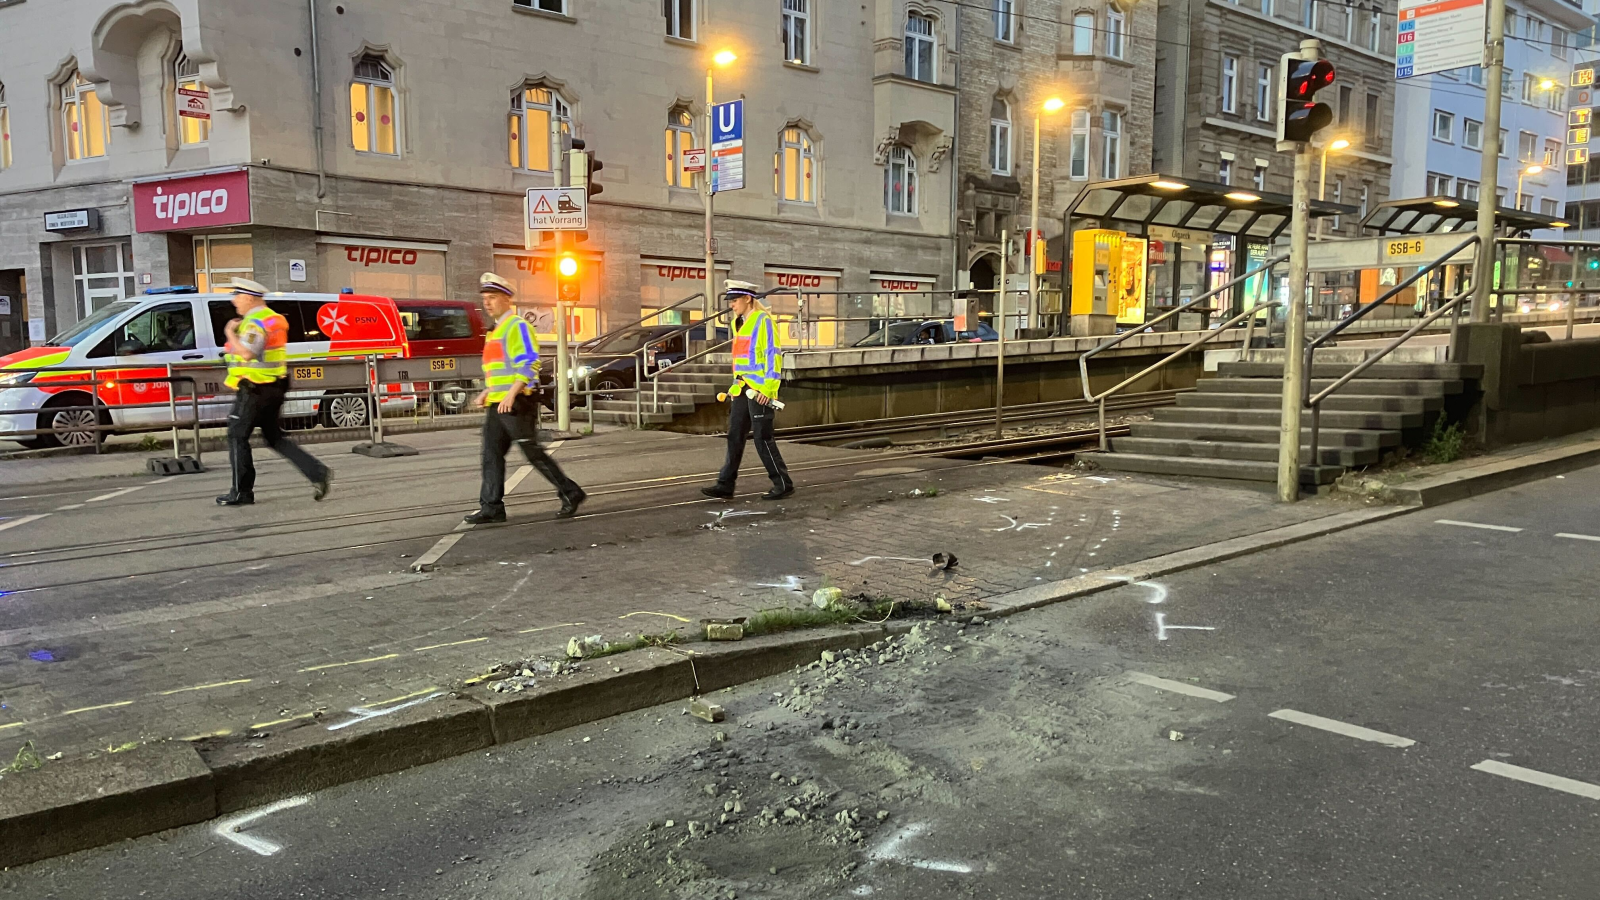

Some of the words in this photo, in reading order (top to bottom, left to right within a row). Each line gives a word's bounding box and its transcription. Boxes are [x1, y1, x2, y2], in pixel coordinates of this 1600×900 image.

[1399, 56, 1412, 65] U12
[1398, 67, 1412, 77] U15
[719, 103, 735, 133] U
[153, 186, 228, 223] tipico
[533, 216, 547, 224] hat
[549, 216, 582, 226] Vorrang
[1390, 241, 1421, 255] SSB-G
[345, 246, 417, 267] tipico
[777, 273, 821, 288] tipico
[881, 280, 918, 291] tipico
[355, 316, 377, 324] PSNV
[432, 359, 454, 370] SSB-G
[296, 368, 322, 379] SSB-G
